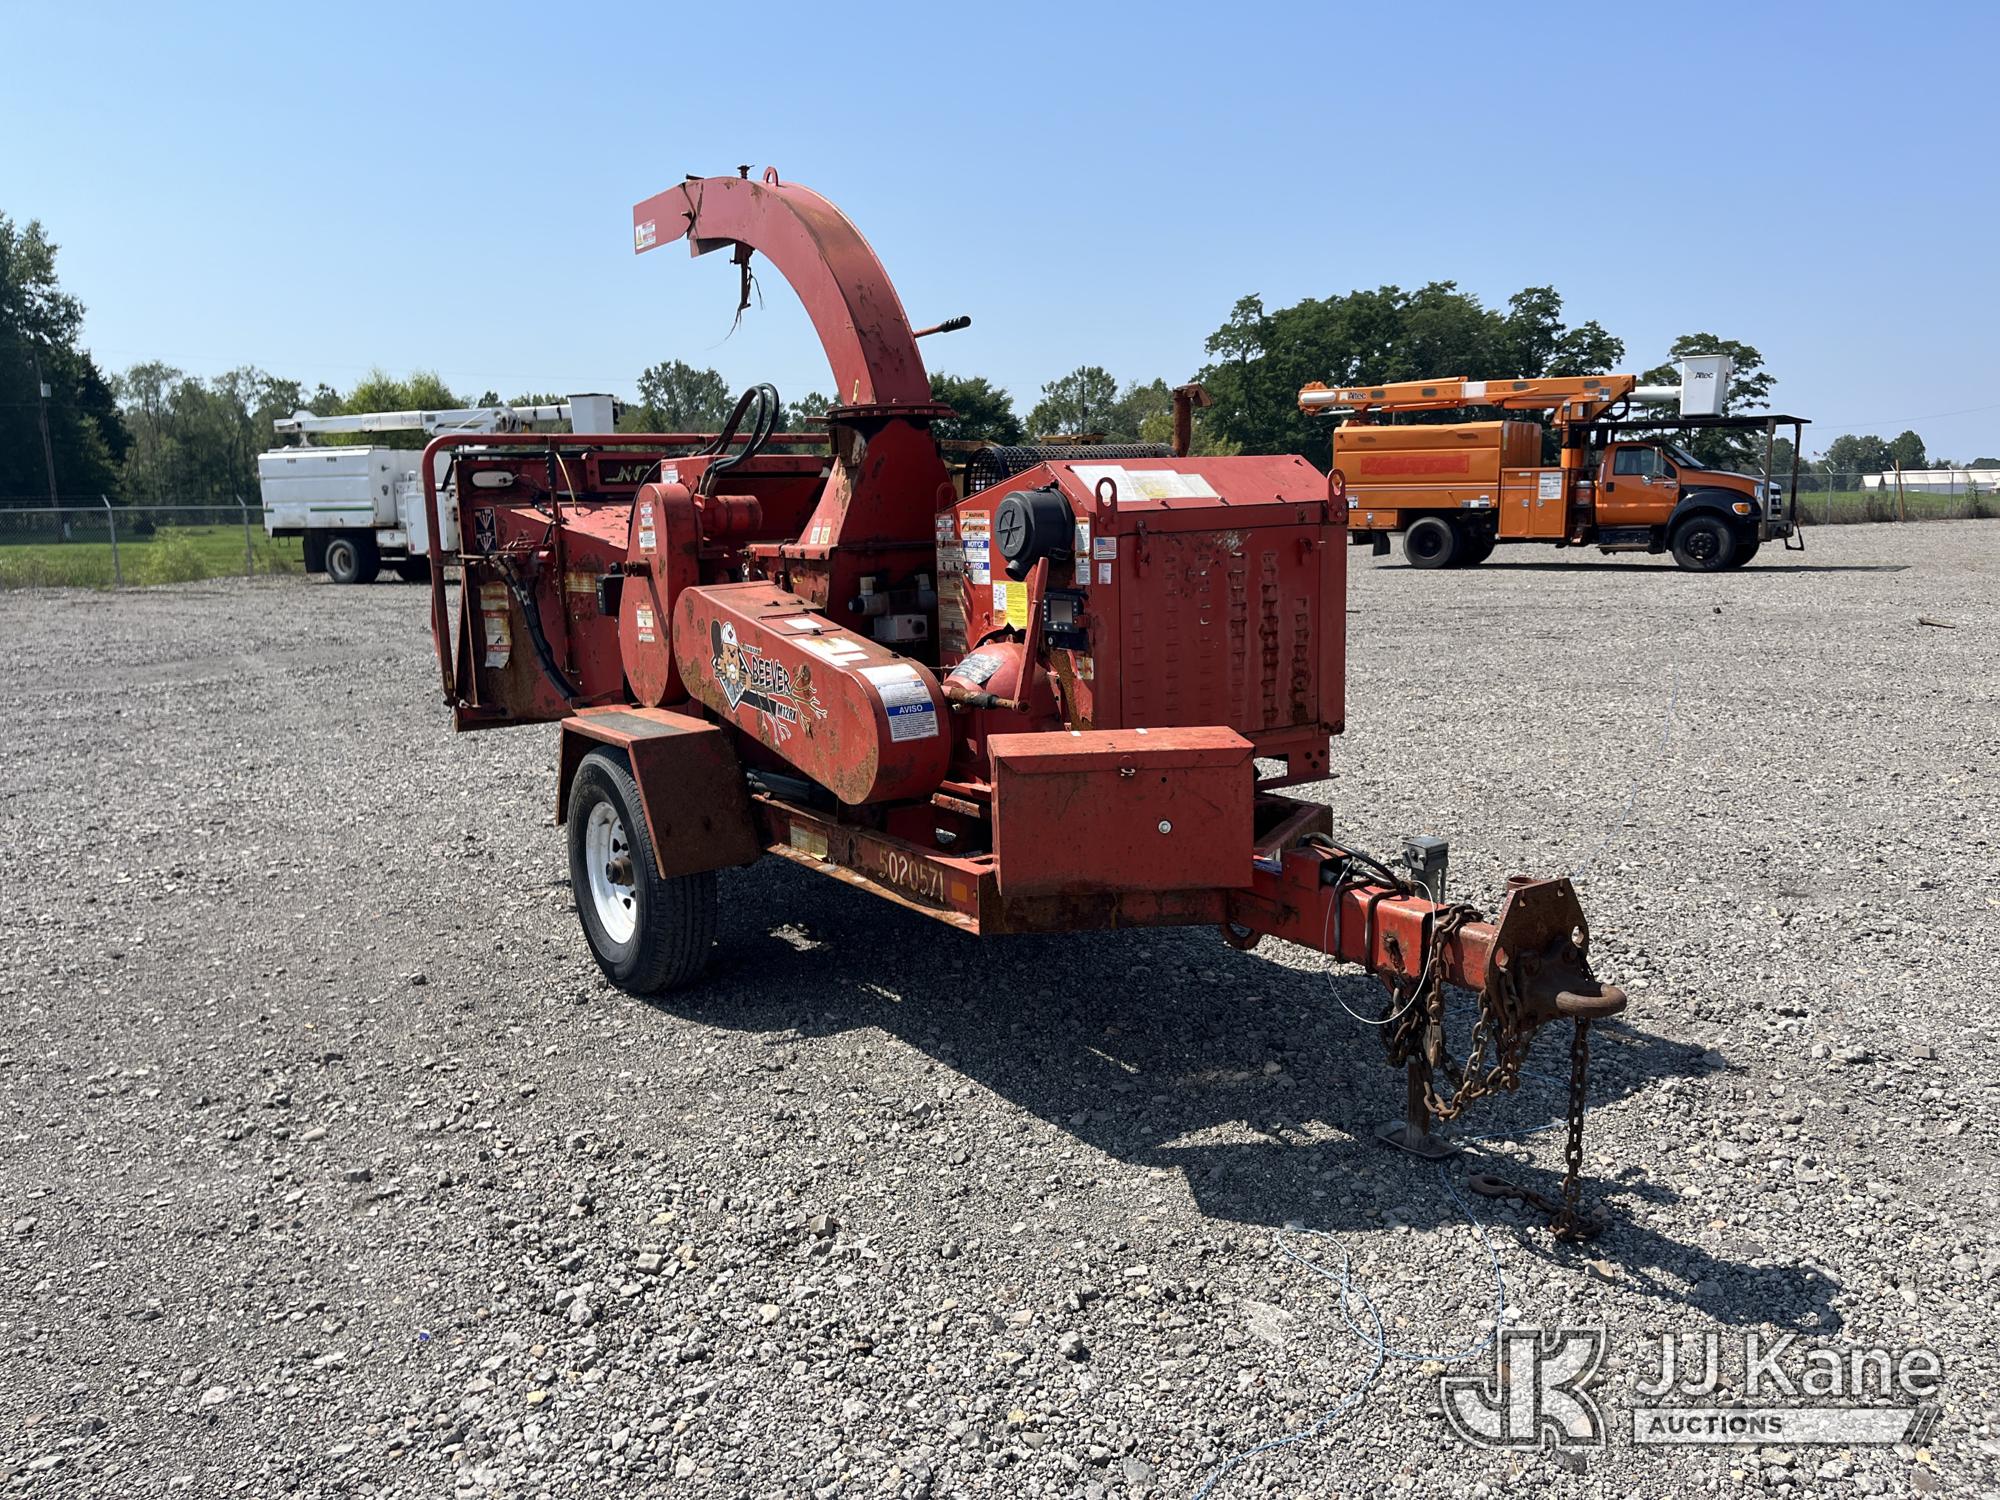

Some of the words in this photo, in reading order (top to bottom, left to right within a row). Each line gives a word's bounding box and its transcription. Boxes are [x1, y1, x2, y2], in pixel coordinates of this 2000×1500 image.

[967, 541, 985, 549] NOTICE
[751, 655, 792, 696] BEEVER
[899, 704, 924, 715] AVISO
[878, 850, 944, 902] 5020571
